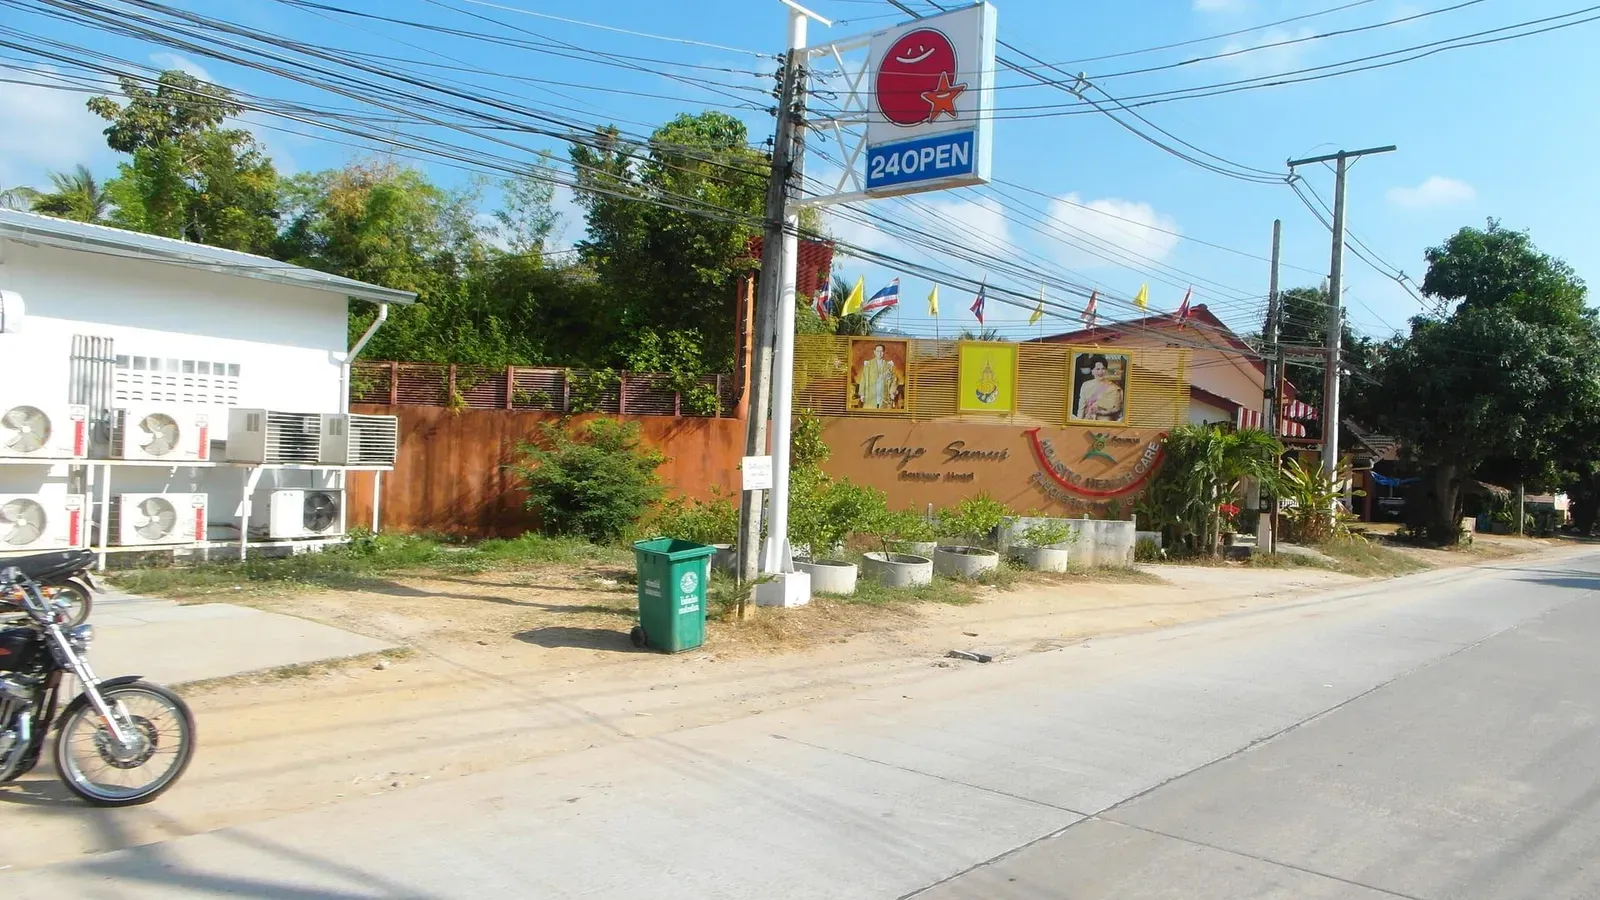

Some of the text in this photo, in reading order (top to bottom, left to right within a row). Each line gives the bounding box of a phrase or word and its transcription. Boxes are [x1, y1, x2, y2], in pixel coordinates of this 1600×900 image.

[871, 141, 969, 179] 24OPEN
[941, 440, 1011, 465] Samui
[1134, 441, 1160, 474] CARE
